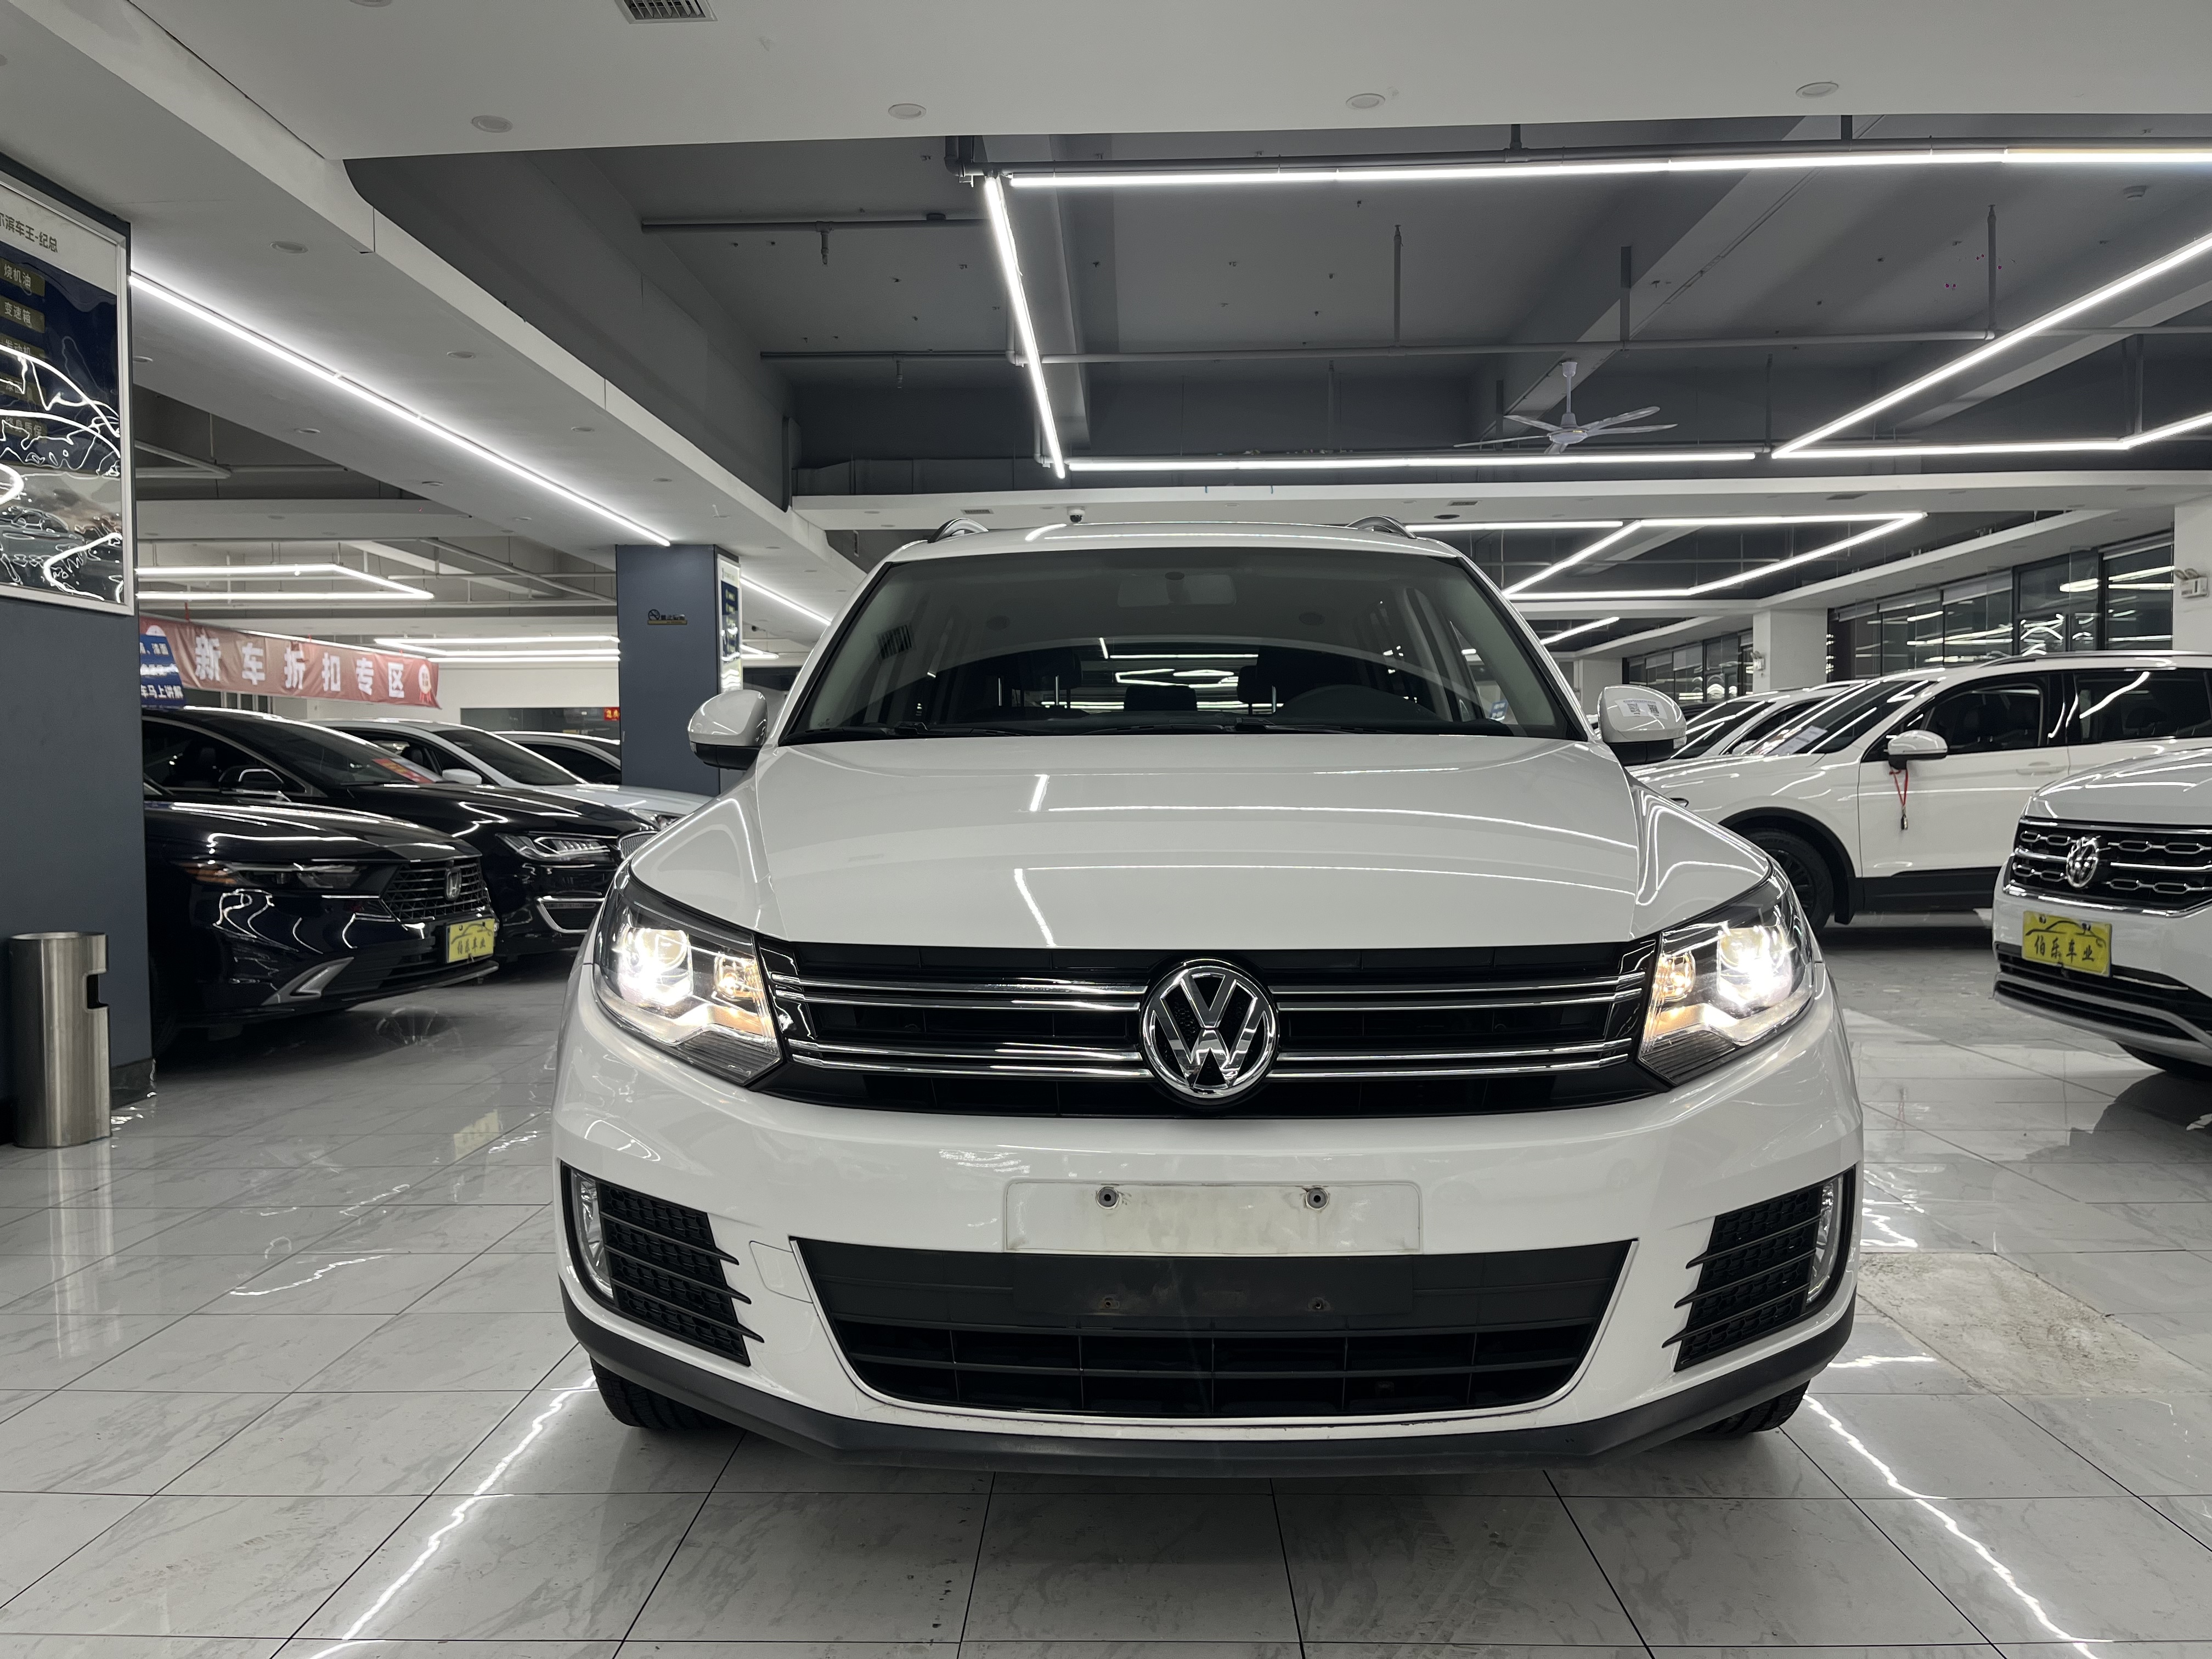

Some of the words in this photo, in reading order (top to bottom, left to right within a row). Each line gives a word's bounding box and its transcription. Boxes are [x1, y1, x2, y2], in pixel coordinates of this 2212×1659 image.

[4, 263, 31, 288] 烧机油
[4, 302, 31, 324] 变速箱
[195, 634, 405, 698] 新车折扣专区
[2034, 935, 2095, 964] 伯乐车业
